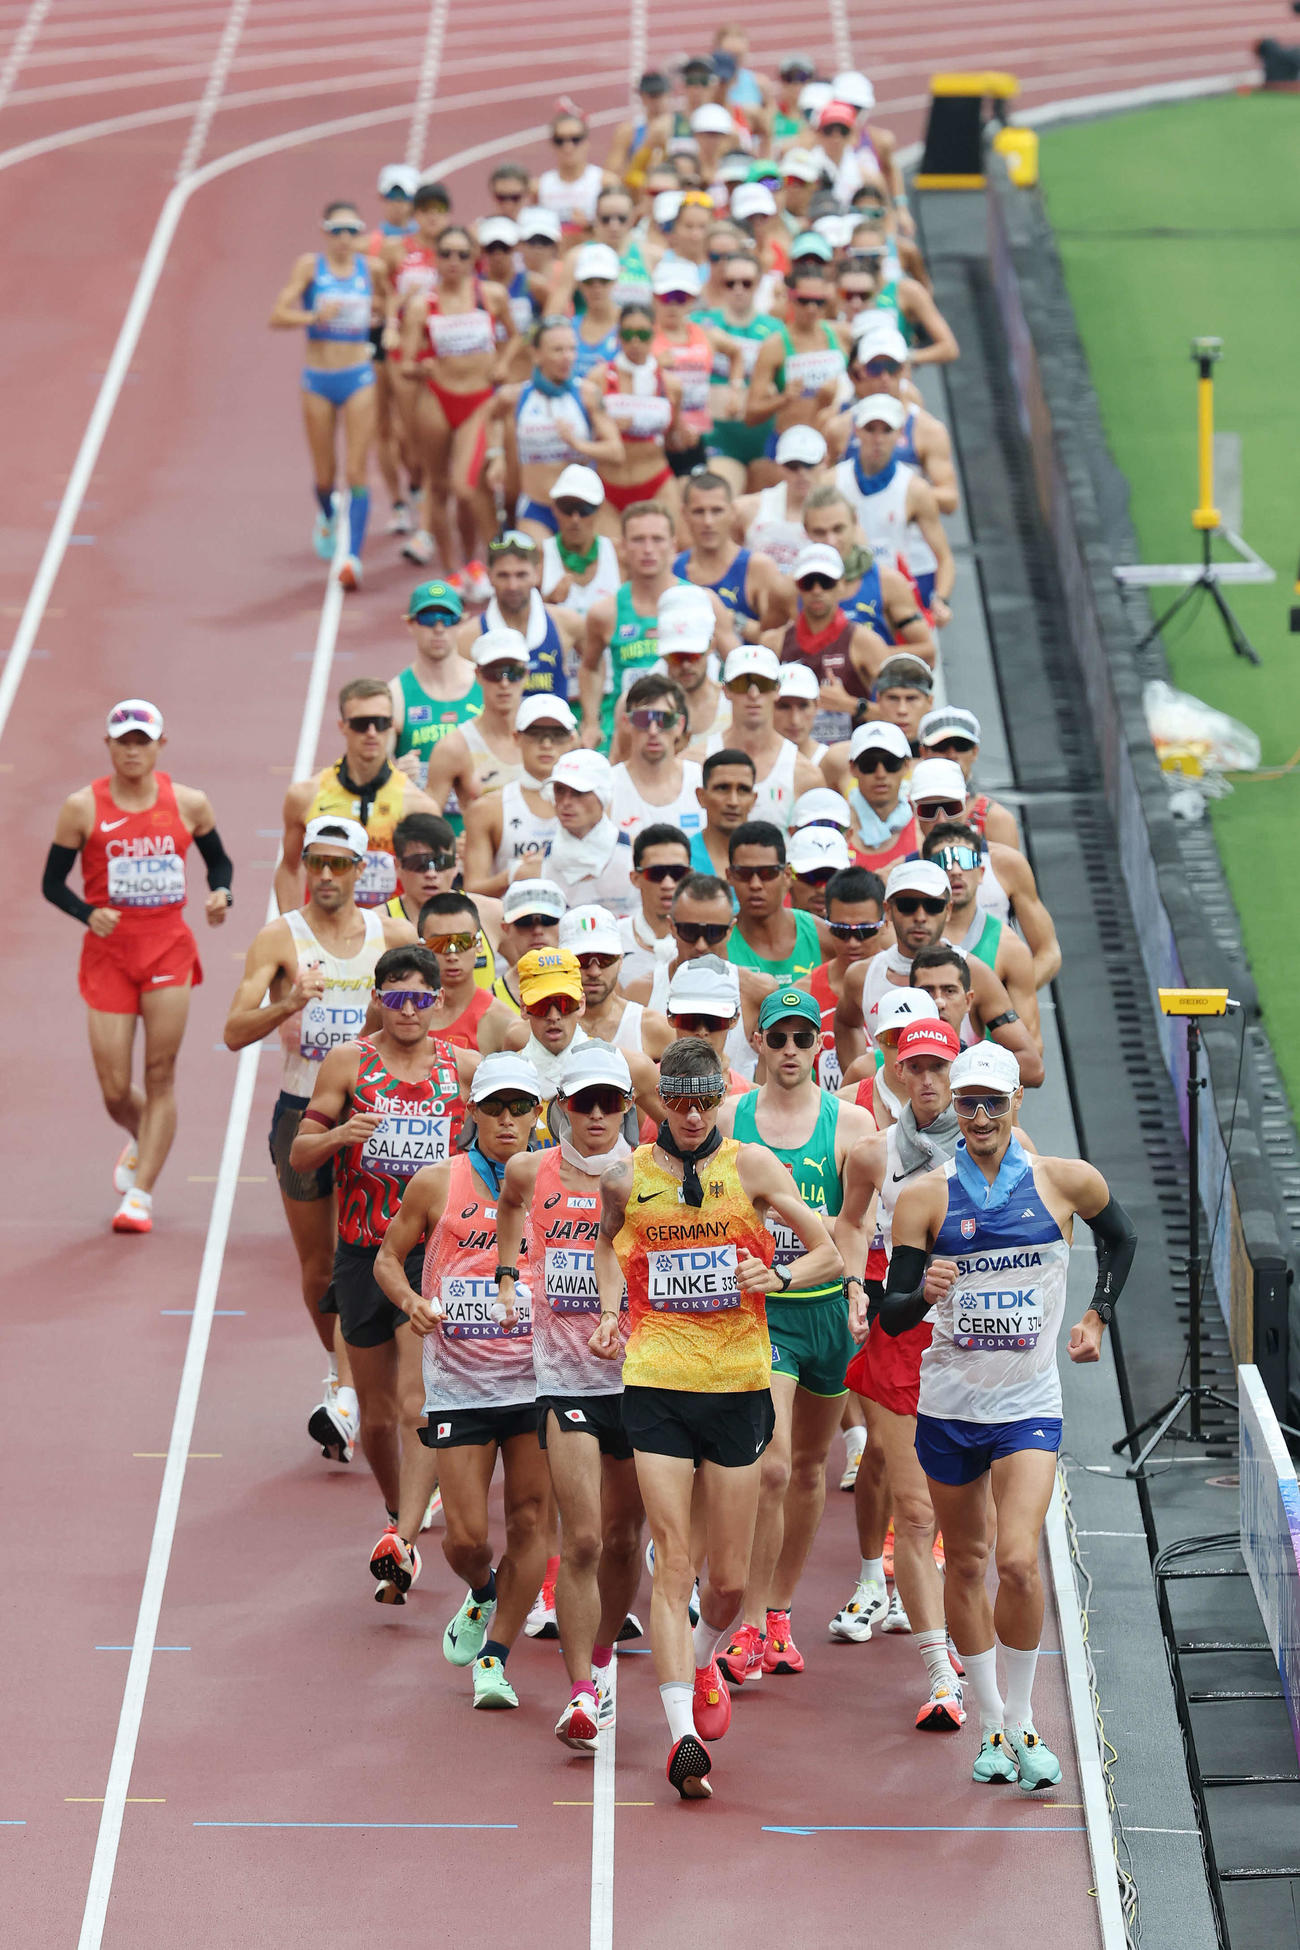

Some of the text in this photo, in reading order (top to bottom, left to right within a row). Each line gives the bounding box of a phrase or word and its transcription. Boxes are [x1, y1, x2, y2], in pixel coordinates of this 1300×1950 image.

[105, 835, 176, 860] CHINA
[131, 860, 177, 873] TDK
[113, 878, 167, 894] ZHOU
[538, 955, 563, 967] SWE
[305, 1027, 361, 1047] LÓPE
[907, 1030, 948, 1045] CANADA
[374, 1095, 445, 1116] MÉXICO
[390, 1117, 444, 1136] TDK
[368, 1138, 445, 1159] SALAZAR
[646, 1221, 730, 1241] GERMANY
[671, 1249, 731, 1271] TDK
[957, 1252, 1042, 1276] SLOVAKIA
[653, 1274, 717, 1296] LINKE
[976, 1289, 1036, 1310] TDK
[958, 1312, 1023, 1334] ČERNÝ
